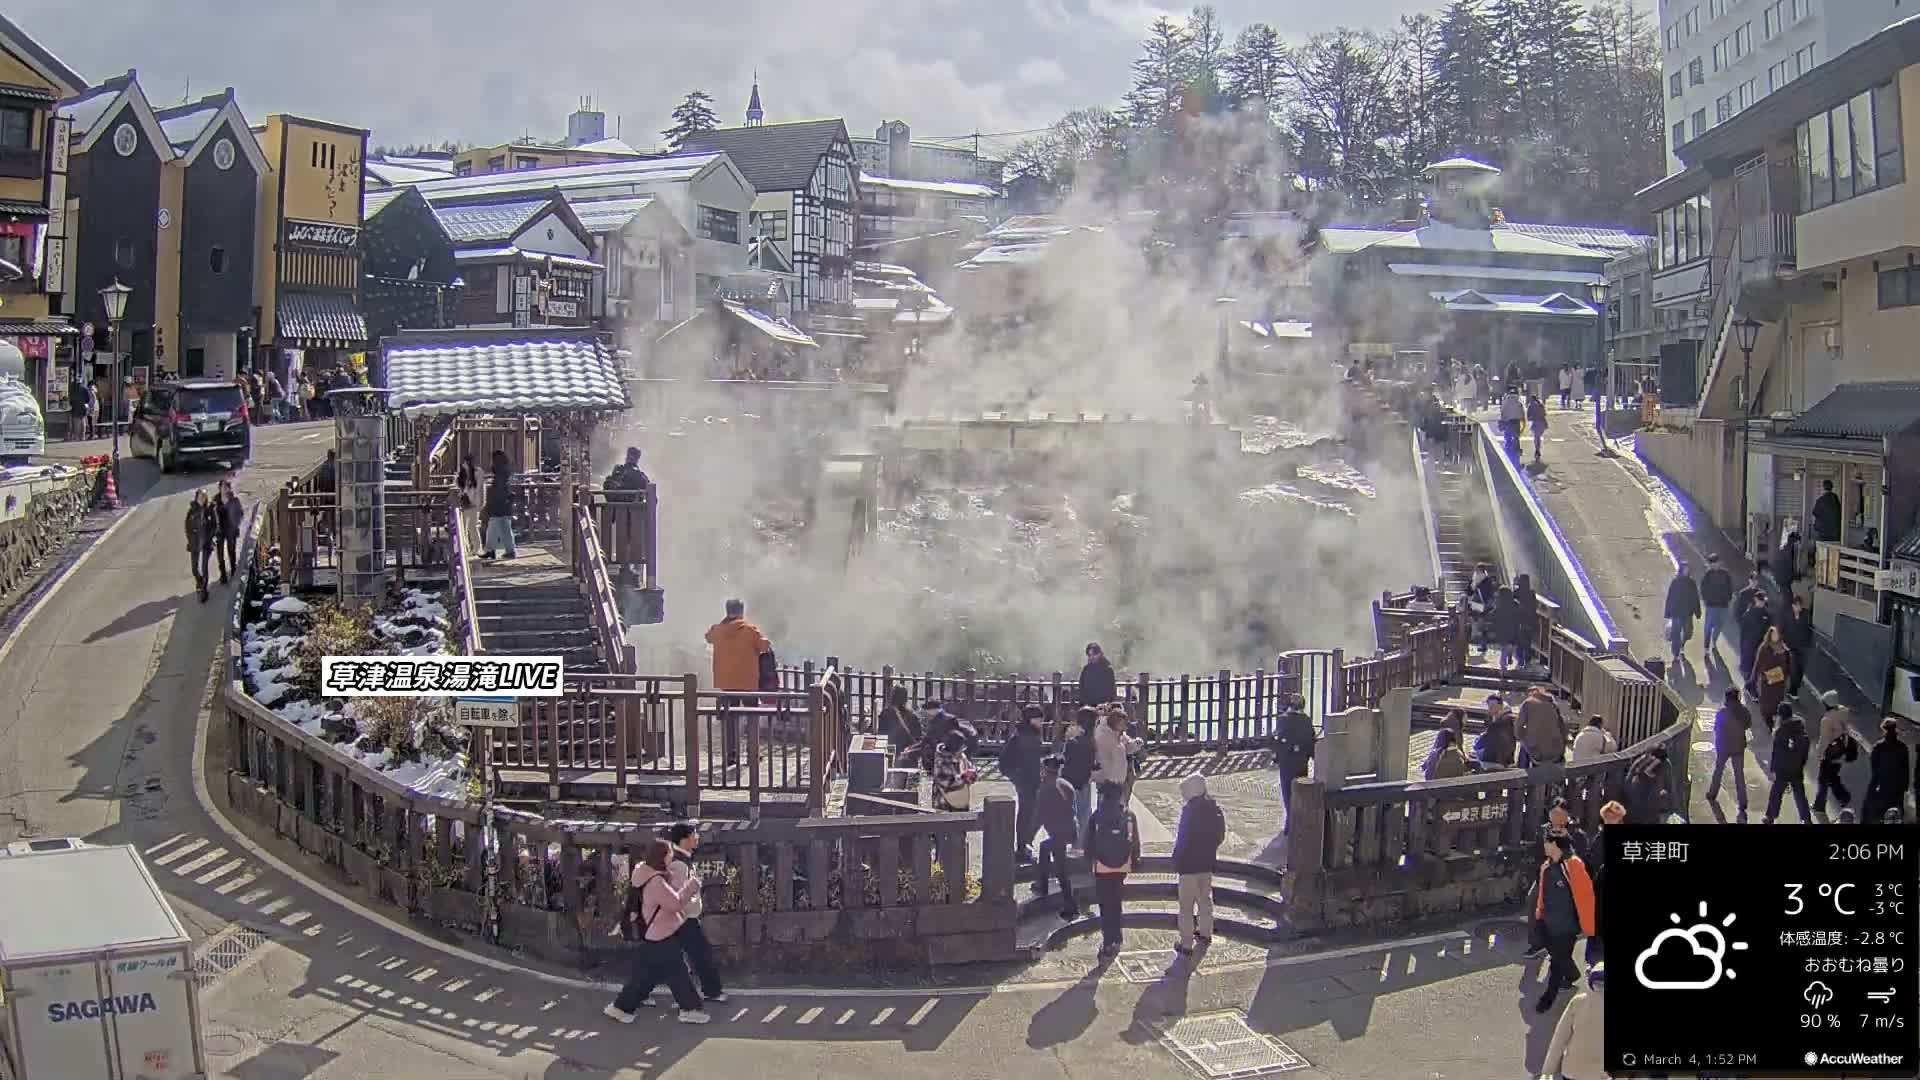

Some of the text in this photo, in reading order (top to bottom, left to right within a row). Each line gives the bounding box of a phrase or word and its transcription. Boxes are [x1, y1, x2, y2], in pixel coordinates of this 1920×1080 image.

[459, 706, 516, 722] 自転車を除く
[48, 992, 156, 1023] SAGAWA
